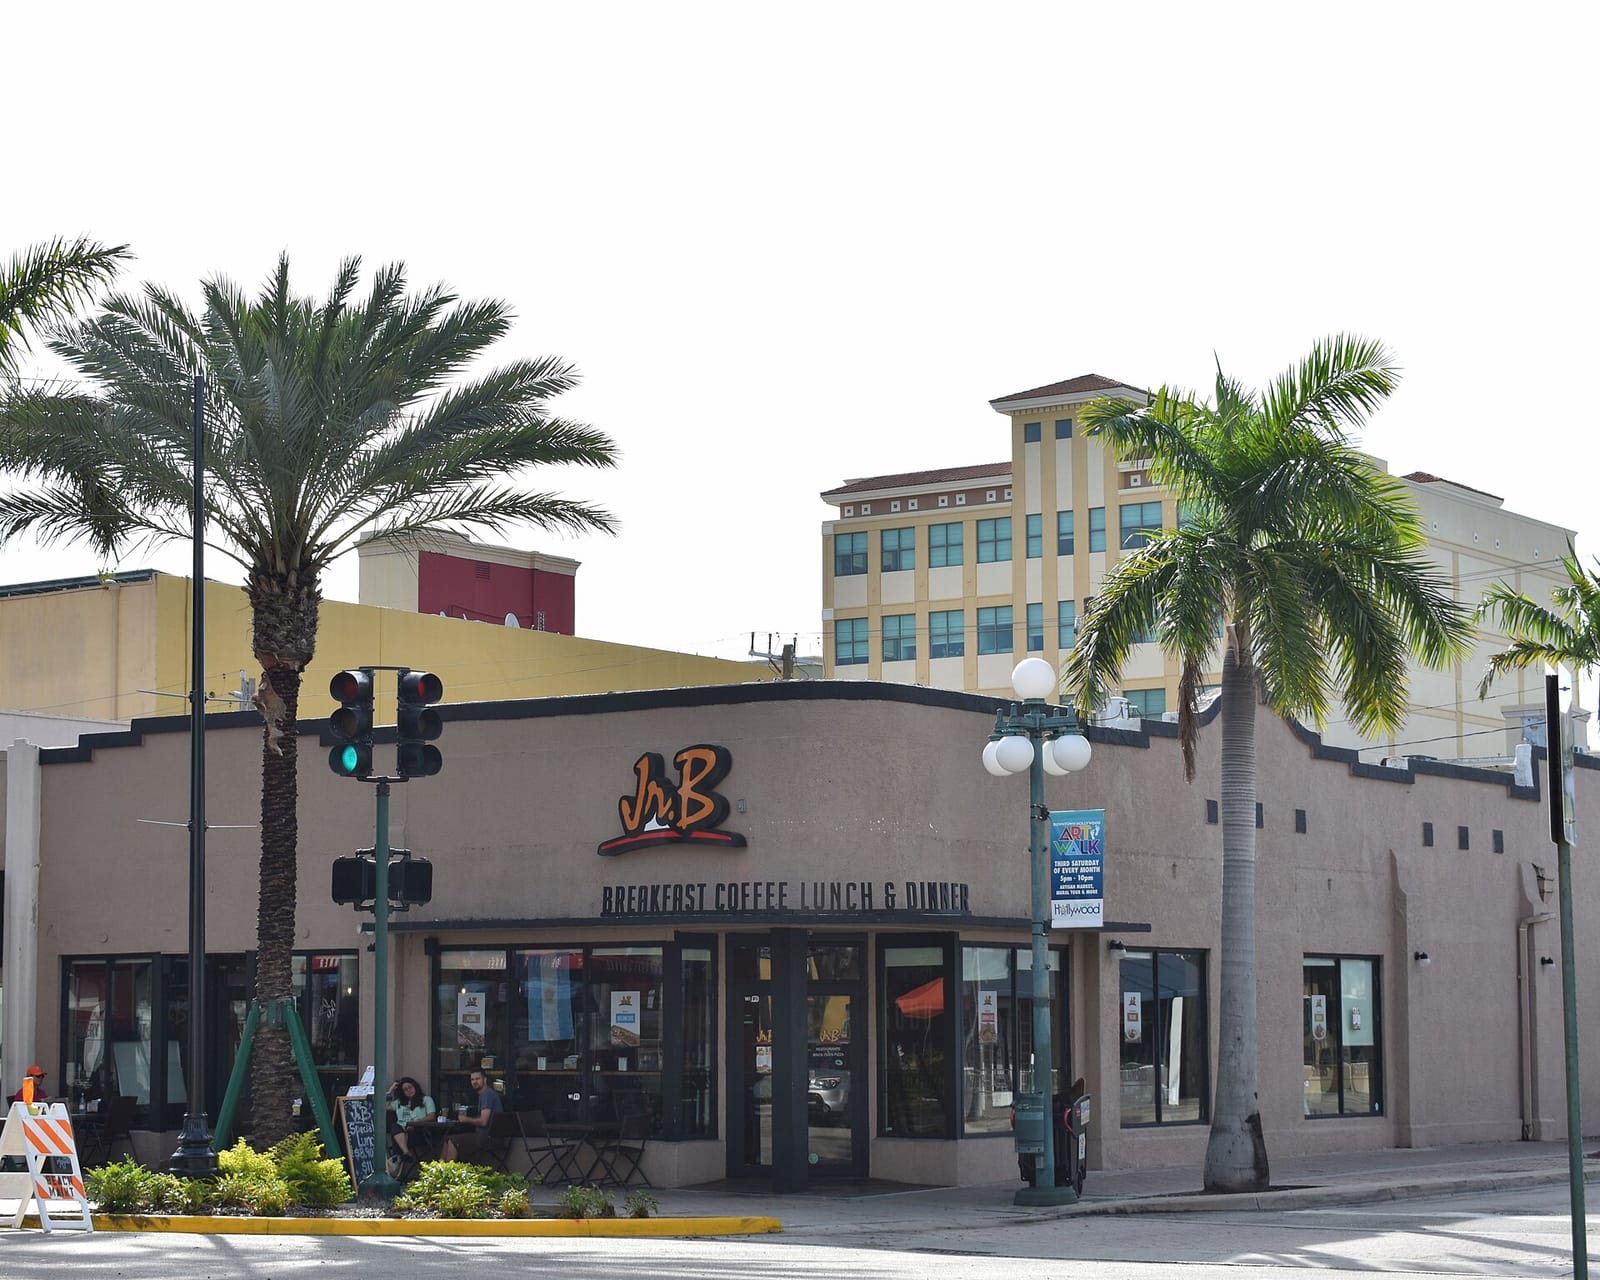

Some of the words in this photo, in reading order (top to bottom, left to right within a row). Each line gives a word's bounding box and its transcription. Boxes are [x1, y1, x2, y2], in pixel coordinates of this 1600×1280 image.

[1058, 825, 1091, 841] ART
[1053, 840, 1101, 856] WALK
[1060, 875, 1072, 883] 5pm
[1077, 874, 1093, 882] 10pm
[603, 883, 706, 912] BREAKFAST
[715, 882, 788, 910] COFFEE
[801, 882, 872, 910] LUNCH
[884, 881, 896, 909] &
[906, 881, 969, 910] DINNER
[1054, 903, 1100, 917] Hollywood
[45, 1175, 73, 1185] BEACH
[48, 1186, 74, 1197] MAINT
